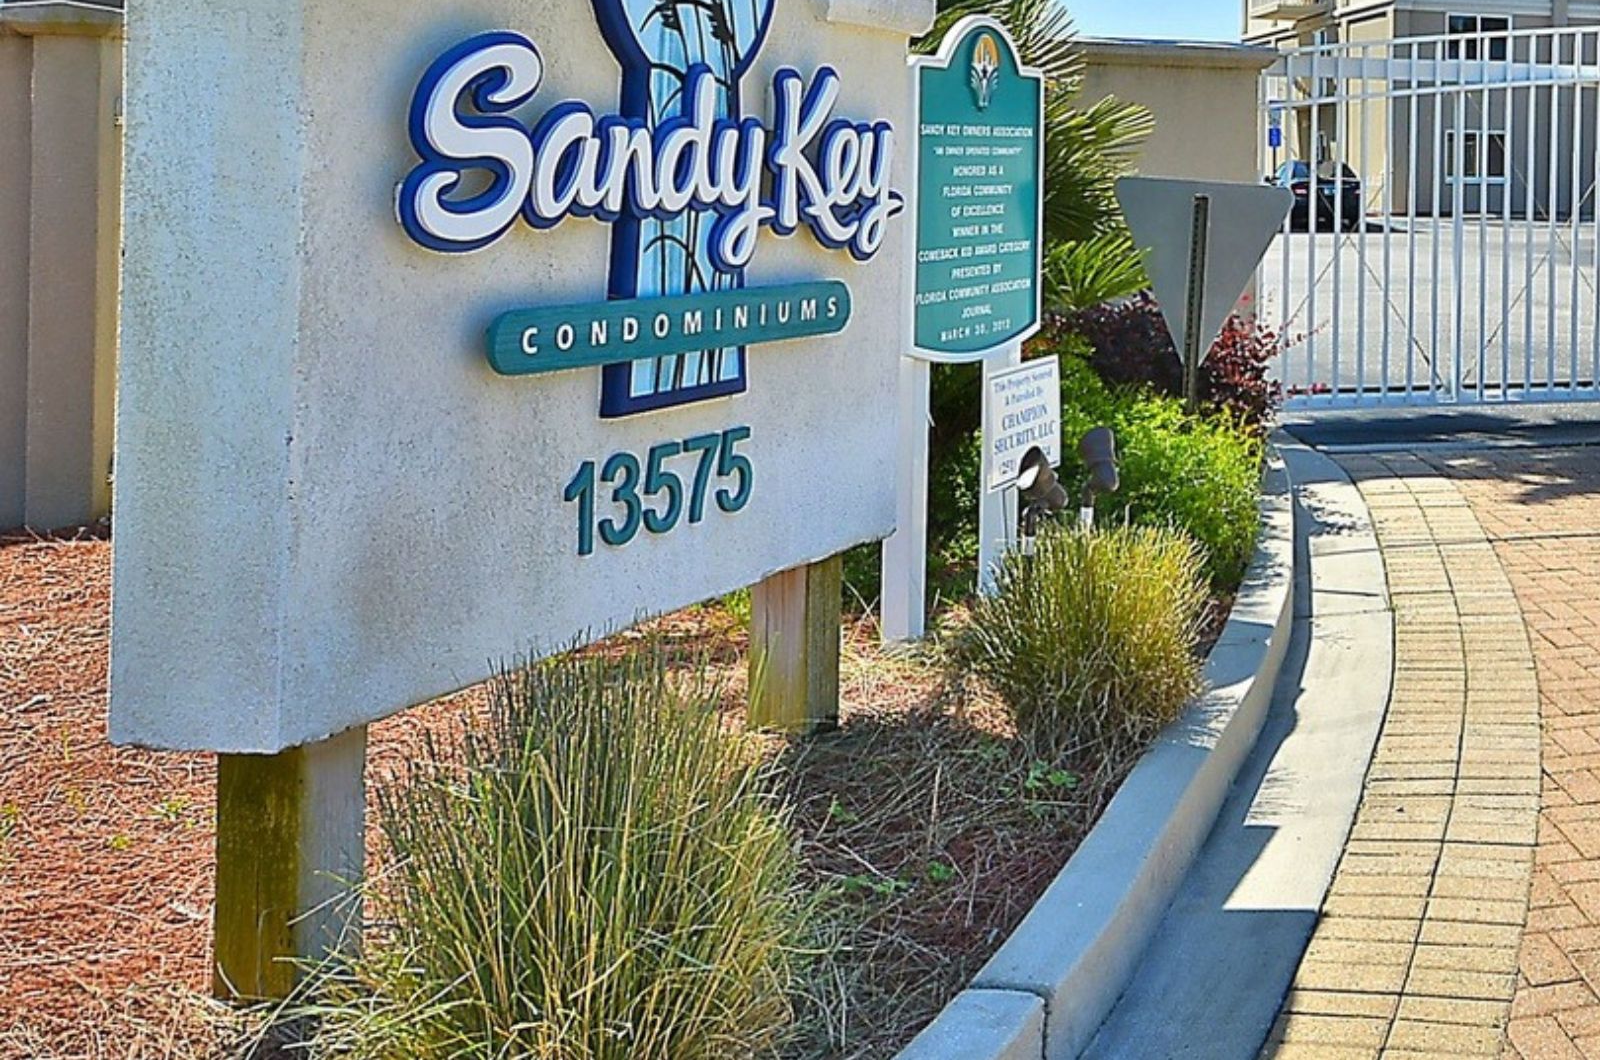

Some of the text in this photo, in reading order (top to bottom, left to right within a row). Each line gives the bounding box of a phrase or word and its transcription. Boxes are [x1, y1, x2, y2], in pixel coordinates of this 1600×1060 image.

[920, 124, 1033, 137] SANDY KEY OWNERS ASSOCIATION
[398, 31, 904, 273] Sandy Key
[953, 164, 1004, 176] HONORED AS A
[943, 184, 1013, 197] FLORIDA COMMUNITY
[951, 204, 1004, 217] OF EXCELLENCE
[952, 223, 1004, 237] WINNER IN THE
[918, 248, 958, 262] COMEBACK
[975, 243, 997, 255] AWARD
[999, 240, 1031, 253] CATEGORY
[951, 263, 1002, 279] PRESENTED BY
[915, 278, 1031, 305] FLORIDA COMMUNITY ASSOCIATION
[961, 304, 992, 318] JOURNAL
[521, 296, 838, 354] CONDOMINIUMS
[941, 327, 970, 341] MARCH
[1002, 404, 1048, 431] CHAMPION
[1038, 420, 1056, 438] LLC
[564, 425, 753, 556] 13575
